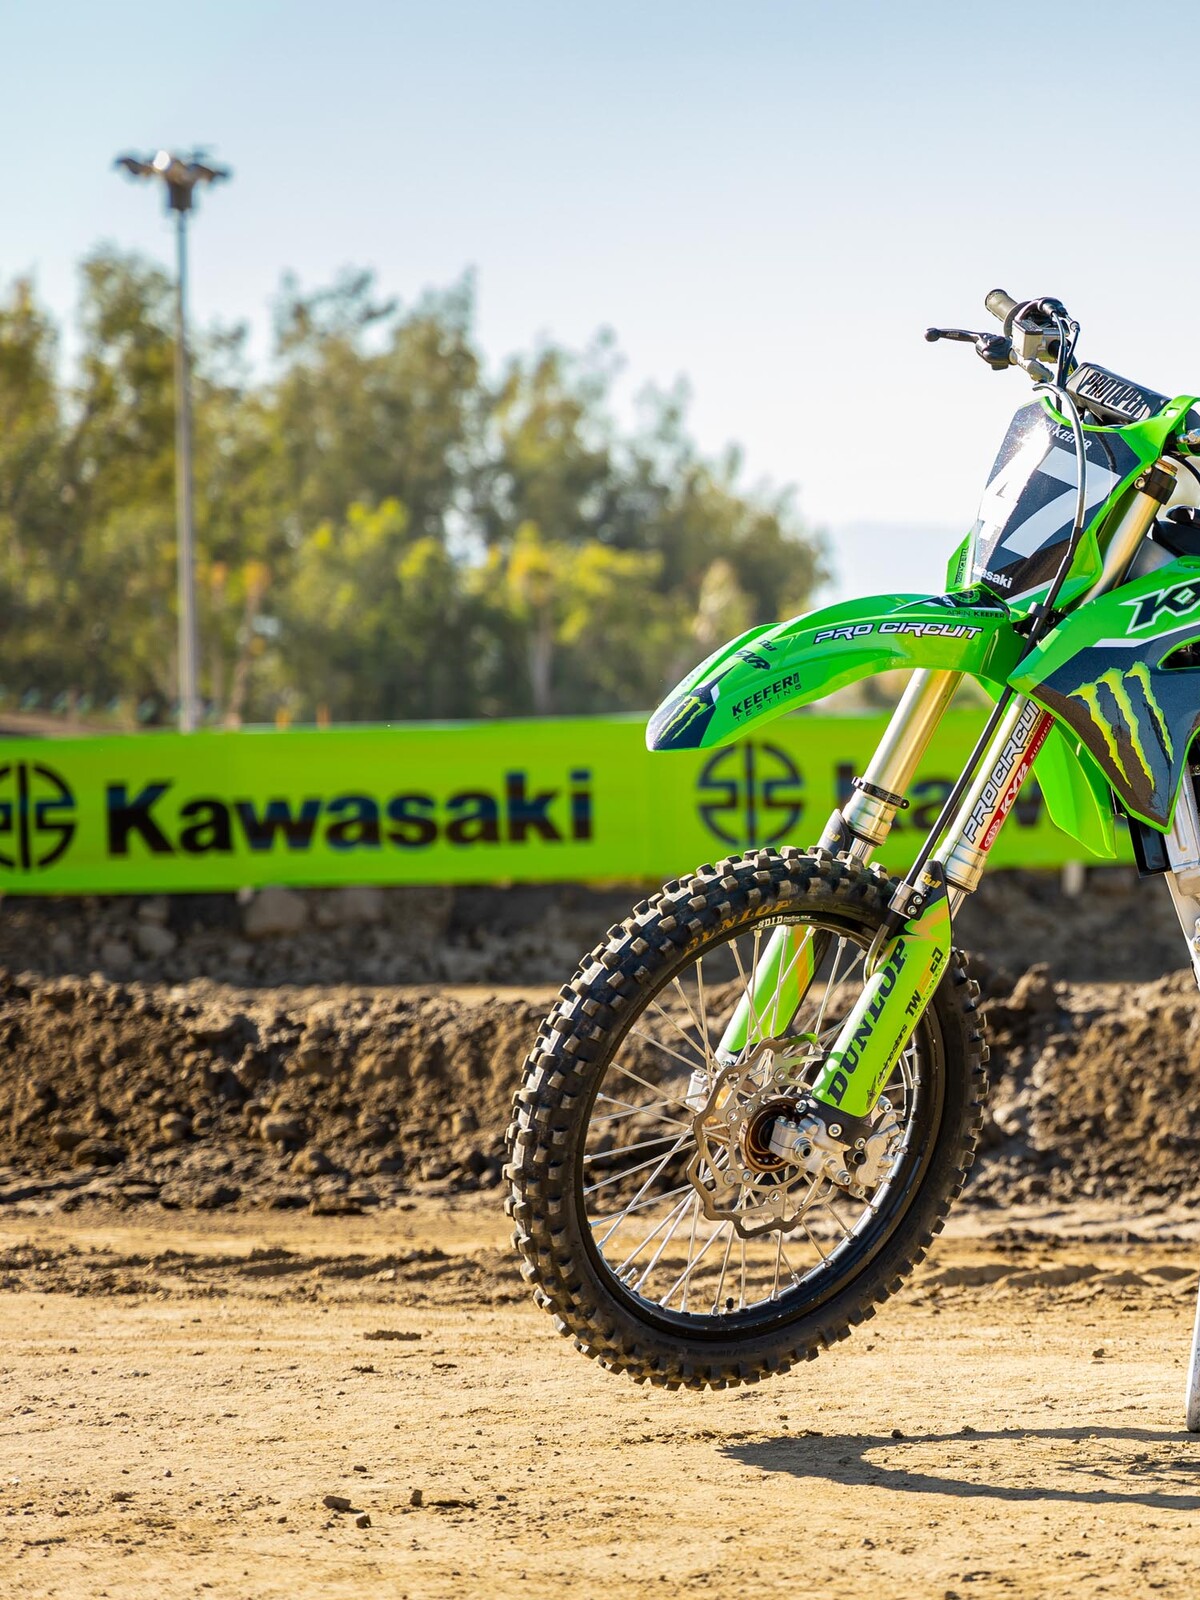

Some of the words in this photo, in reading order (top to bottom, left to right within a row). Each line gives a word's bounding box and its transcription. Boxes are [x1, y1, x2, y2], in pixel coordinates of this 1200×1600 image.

[813, 623, 874, 645] PRO
[878, 621, 983, 640] CIRCUIT
[731, 674, 793, 717] KEEFER
[733, 685, 802, 722] TESTING
[963, 780, 998, 845] PRO
[991, 699, 1041, 788] CIRCUI
[1000, 762, 1029, 815] KYB
[105, 767, 594, 858] Kawasaki
[827, 937, 907, 1107] DUNLOP
